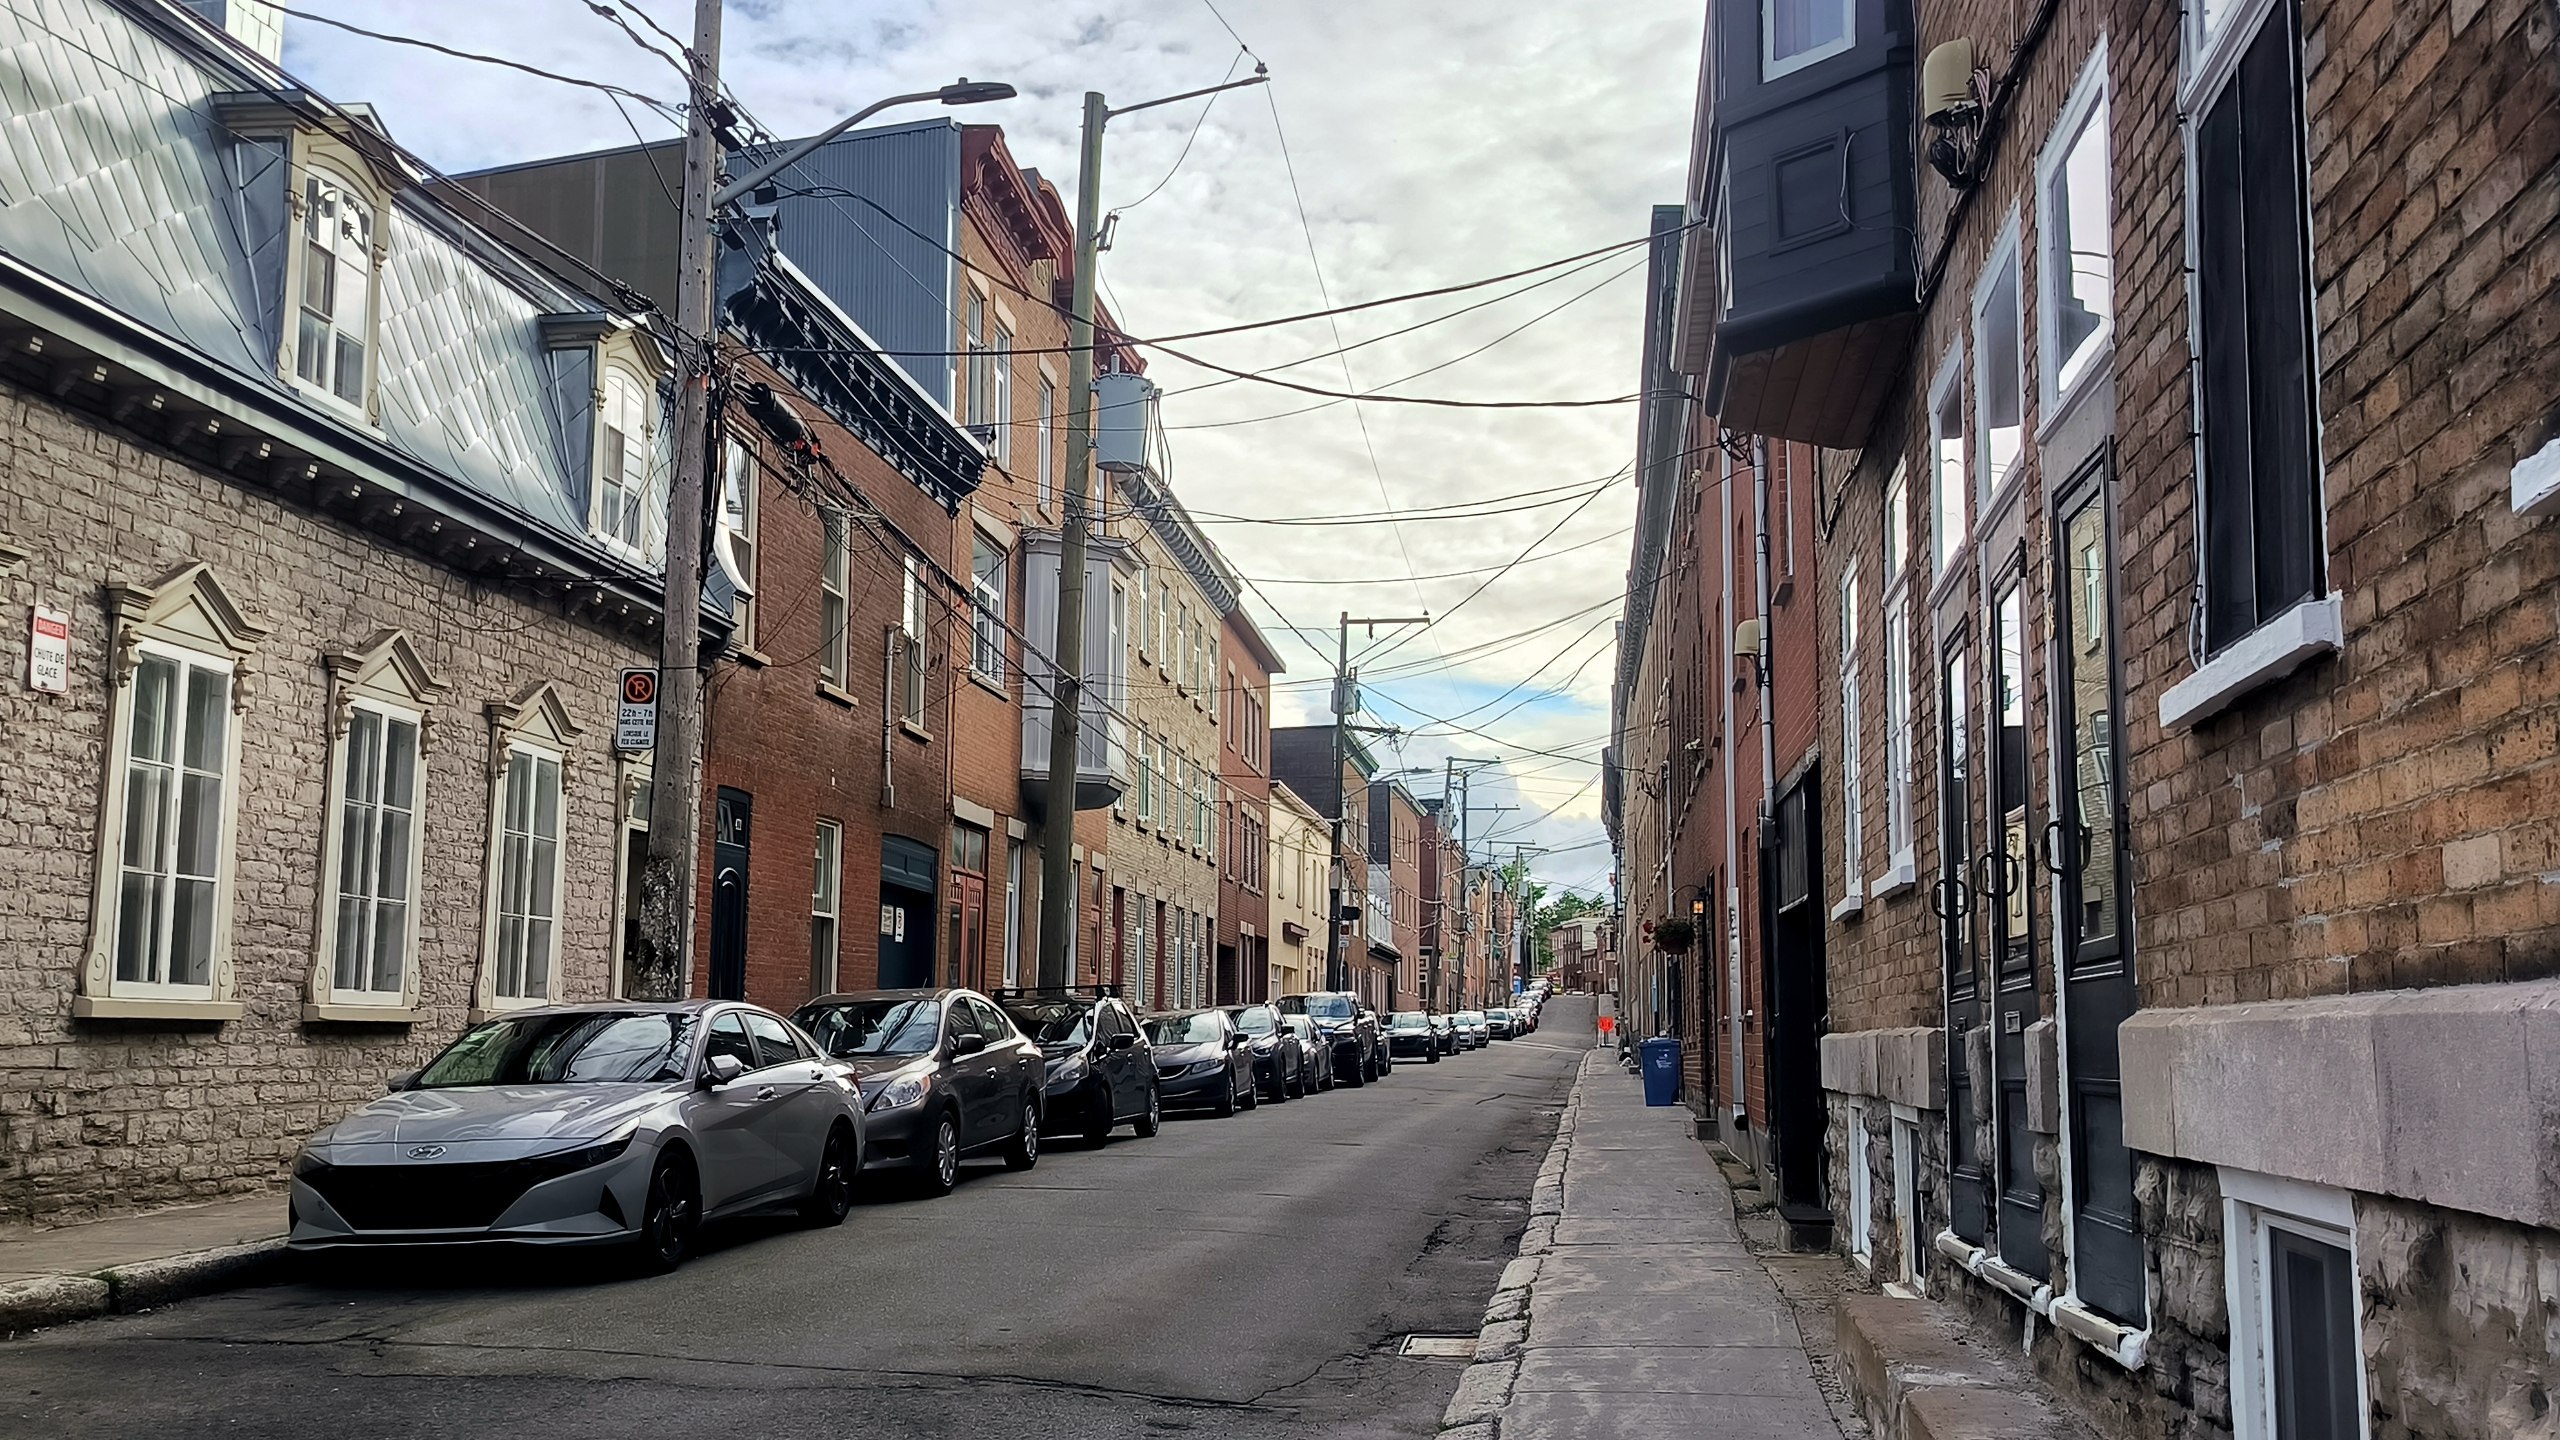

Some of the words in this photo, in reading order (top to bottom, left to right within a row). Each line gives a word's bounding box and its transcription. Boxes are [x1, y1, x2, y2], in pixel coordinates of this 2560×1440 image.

[35, 648, 53, 662] CHUTE
[55, 653, 65, 665] DE
[37, 665, 58, 678] GLACE
[621, 709, 637, 717] 22h
[643, 709, 653, 717] 7h
